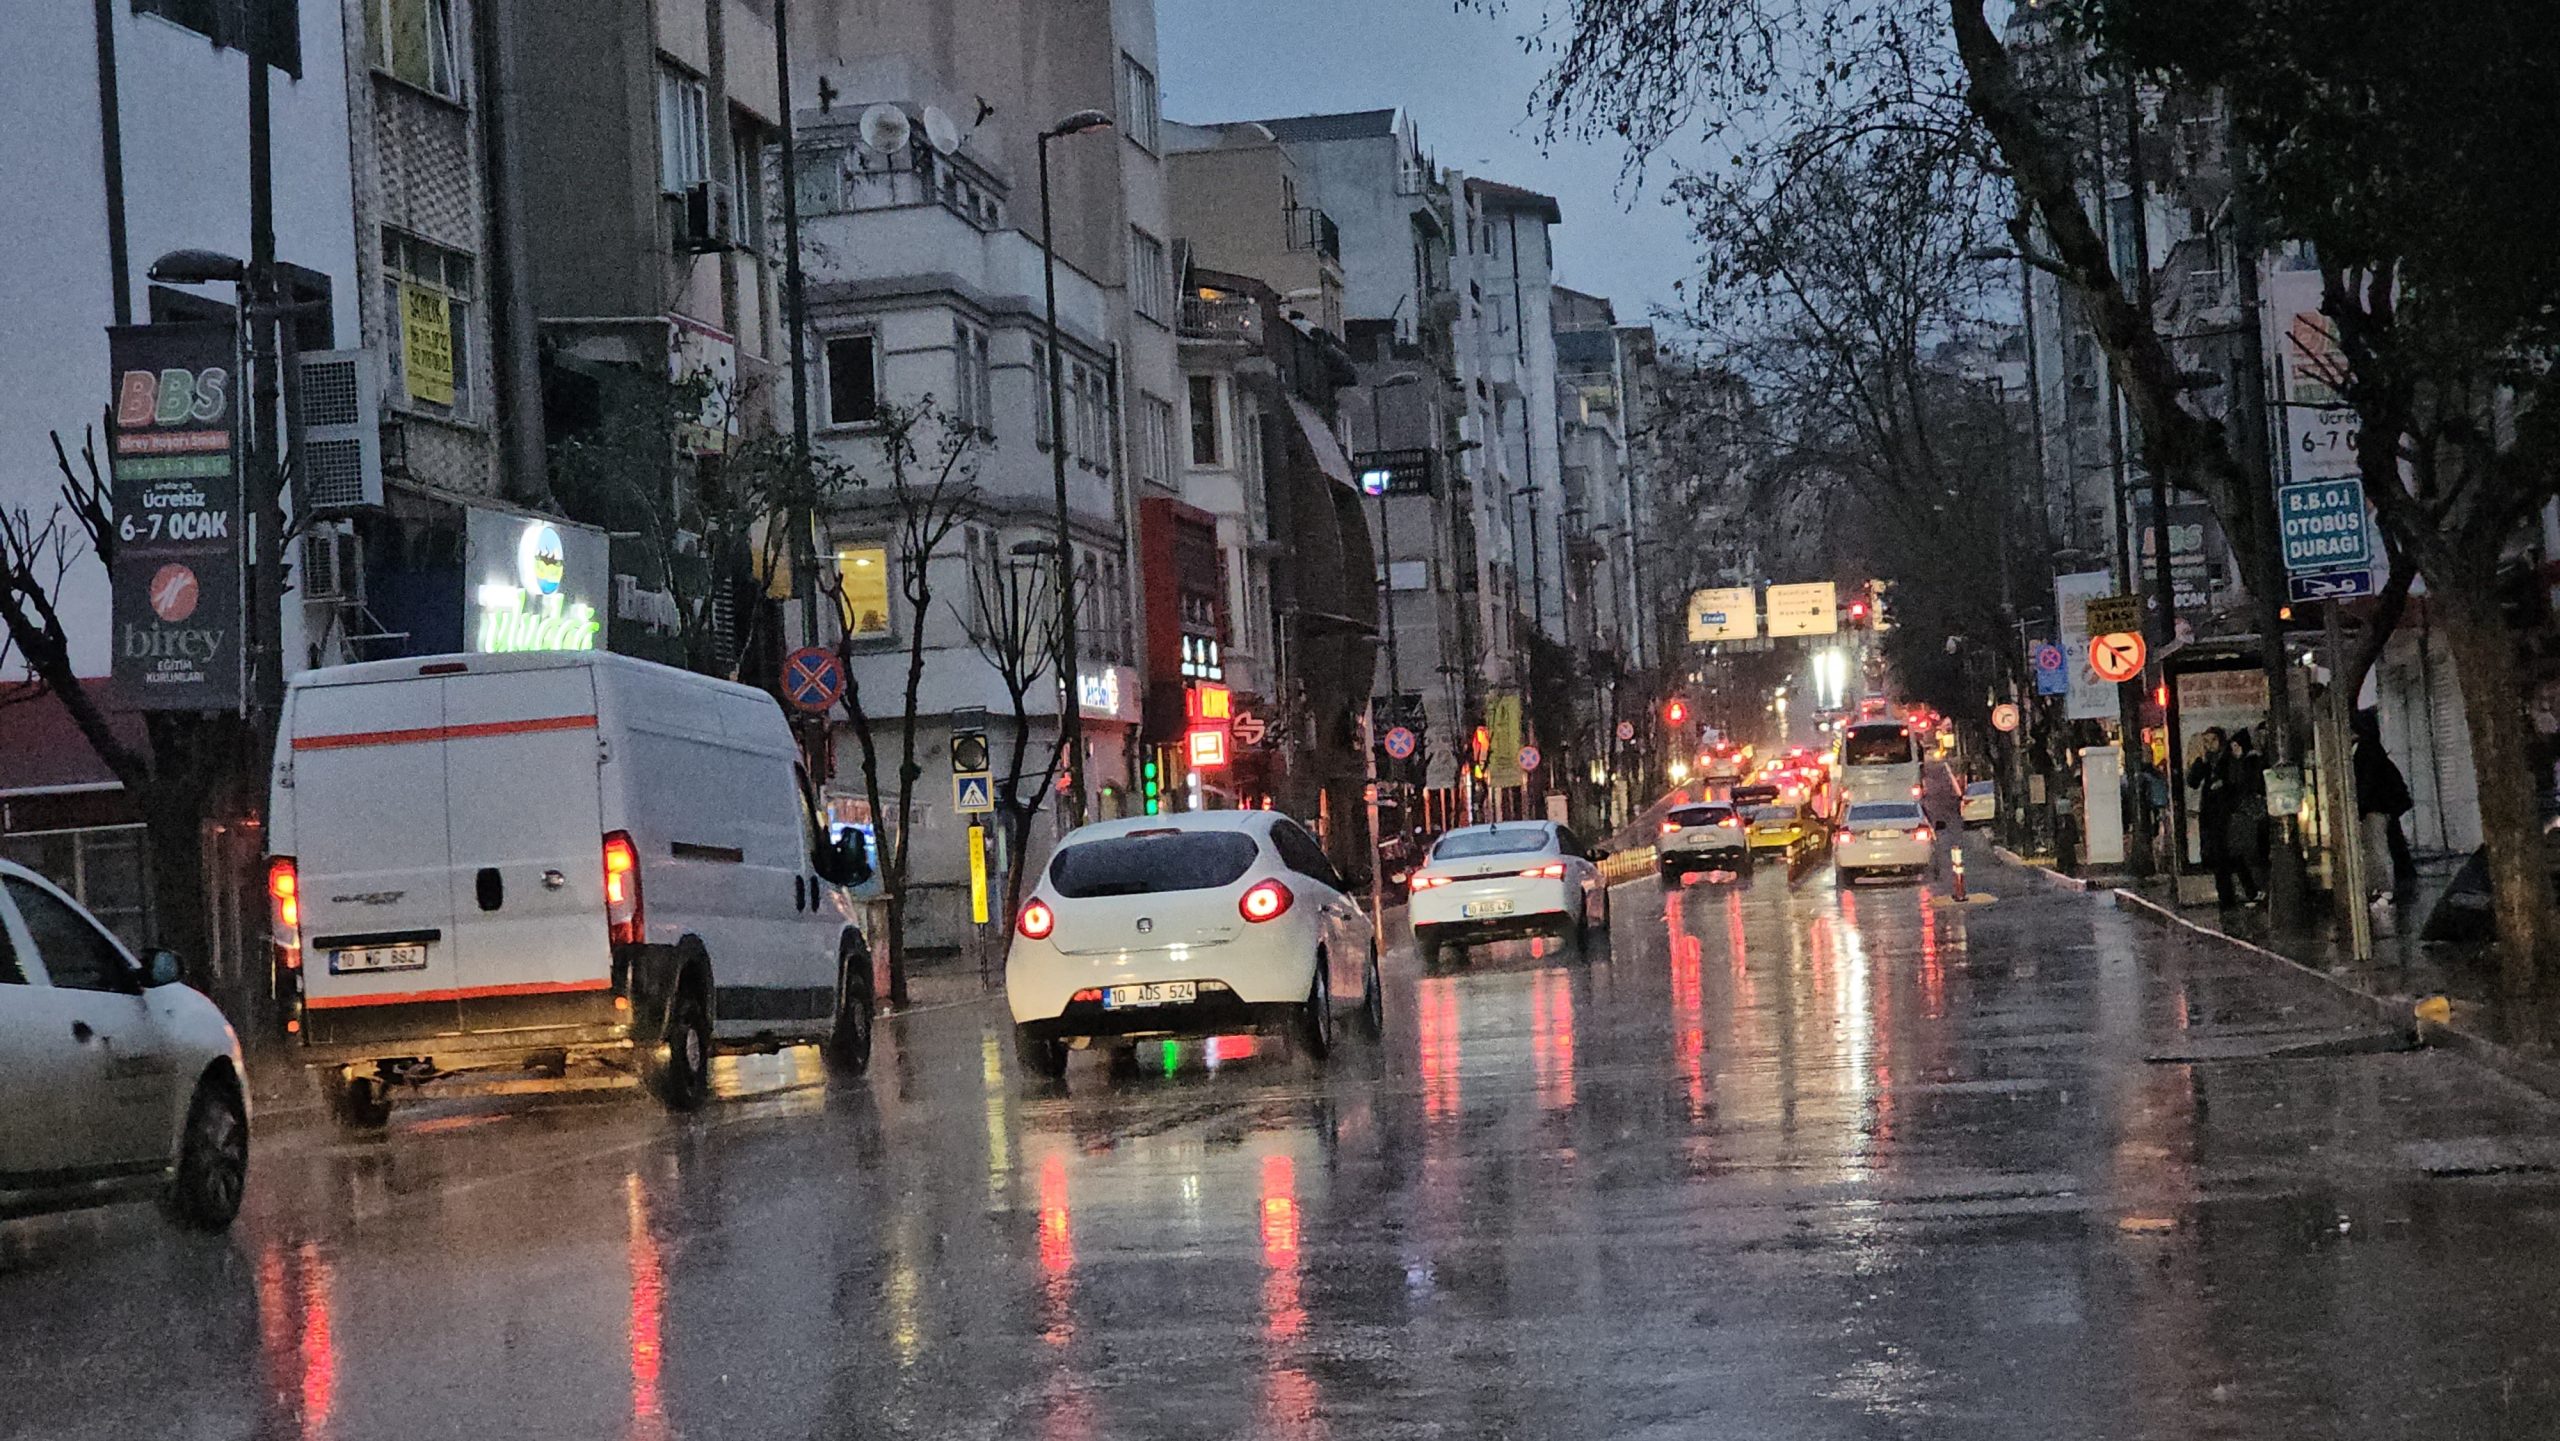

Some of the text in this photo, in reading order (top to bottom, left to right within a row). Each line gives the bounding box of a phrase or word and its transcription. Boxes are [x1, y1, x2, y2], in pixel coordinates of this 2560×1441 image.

[117, 367, 228, 427] BBS
[2302, 430, 2339, 453] 6-7
[143, 489, 206, 508] Ücretsiz
[120, 510, 228, 541] 6-7 OCAK
[2286, 510, 2359, 536] OTOBÜS
[2290, 532, 2360, 558] DURAĞI
[2173, 592, 2207, 608] OCAK
[125, 622, 225, 663] birey
[341, 953, 355, 967] 10
[1112, 984, 1193, 1003] 10 ADS 524
